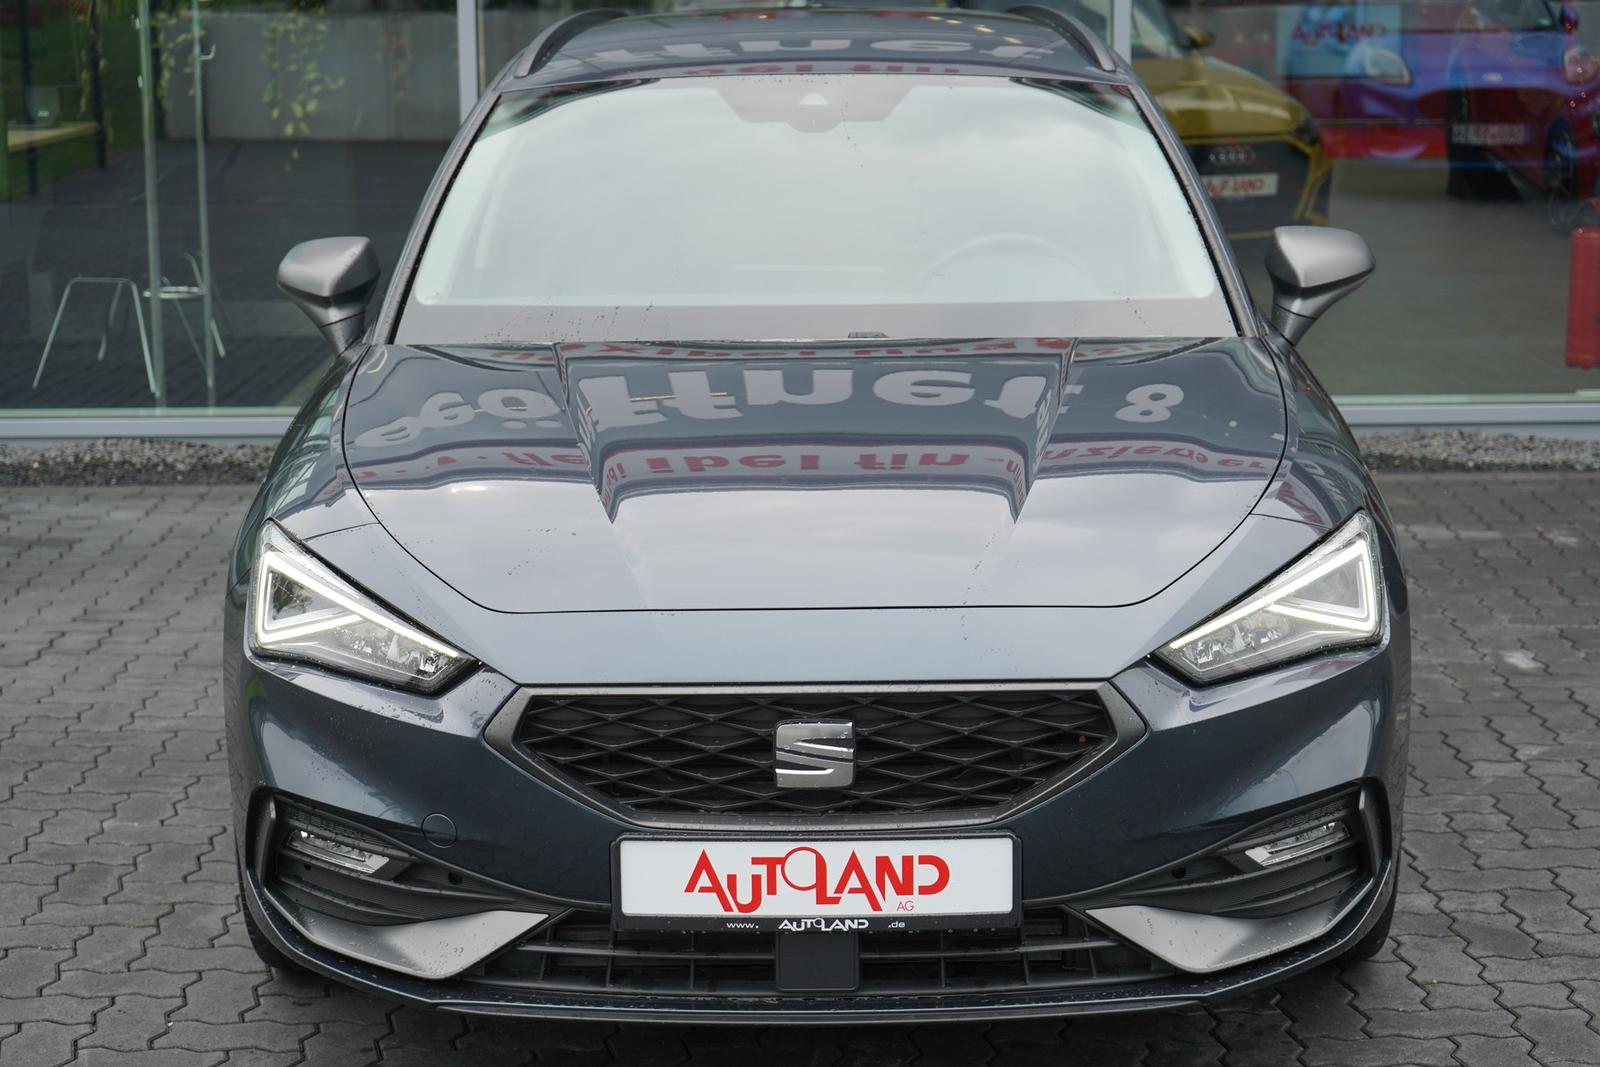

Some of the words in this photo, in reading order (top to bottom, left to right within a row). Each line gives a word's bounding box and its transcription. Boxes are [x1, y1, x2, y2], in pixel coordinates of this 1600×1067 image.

[684, 846, 951, 914] AUTOLAND
[896, 900, 915, 912] AG
[726, 921, 760, 930] www.
[778, 917, 869, 932] AUTOLAND
[887, 921, 906, 929] .de
